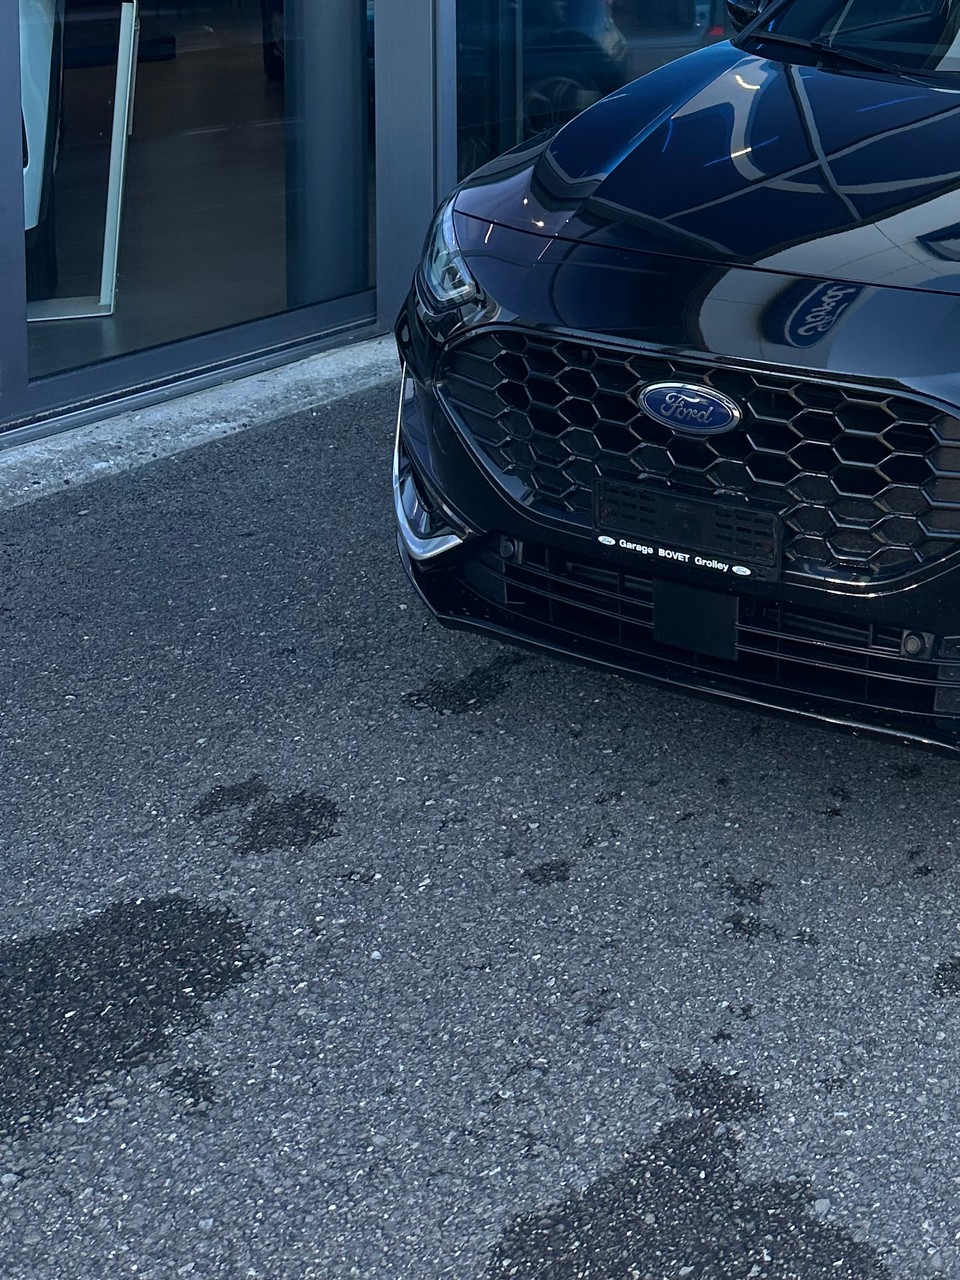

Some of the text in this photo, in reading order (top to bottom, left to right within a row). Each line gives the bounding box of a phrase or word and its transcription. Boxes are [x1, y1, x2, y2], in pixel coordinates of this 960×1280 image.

[660, 392, 713, 424] Ford
[618, 539, 654, 555] Garage
[658, 548, 690, 562] BOVET
[694, 556, 729, 572] Grolley
